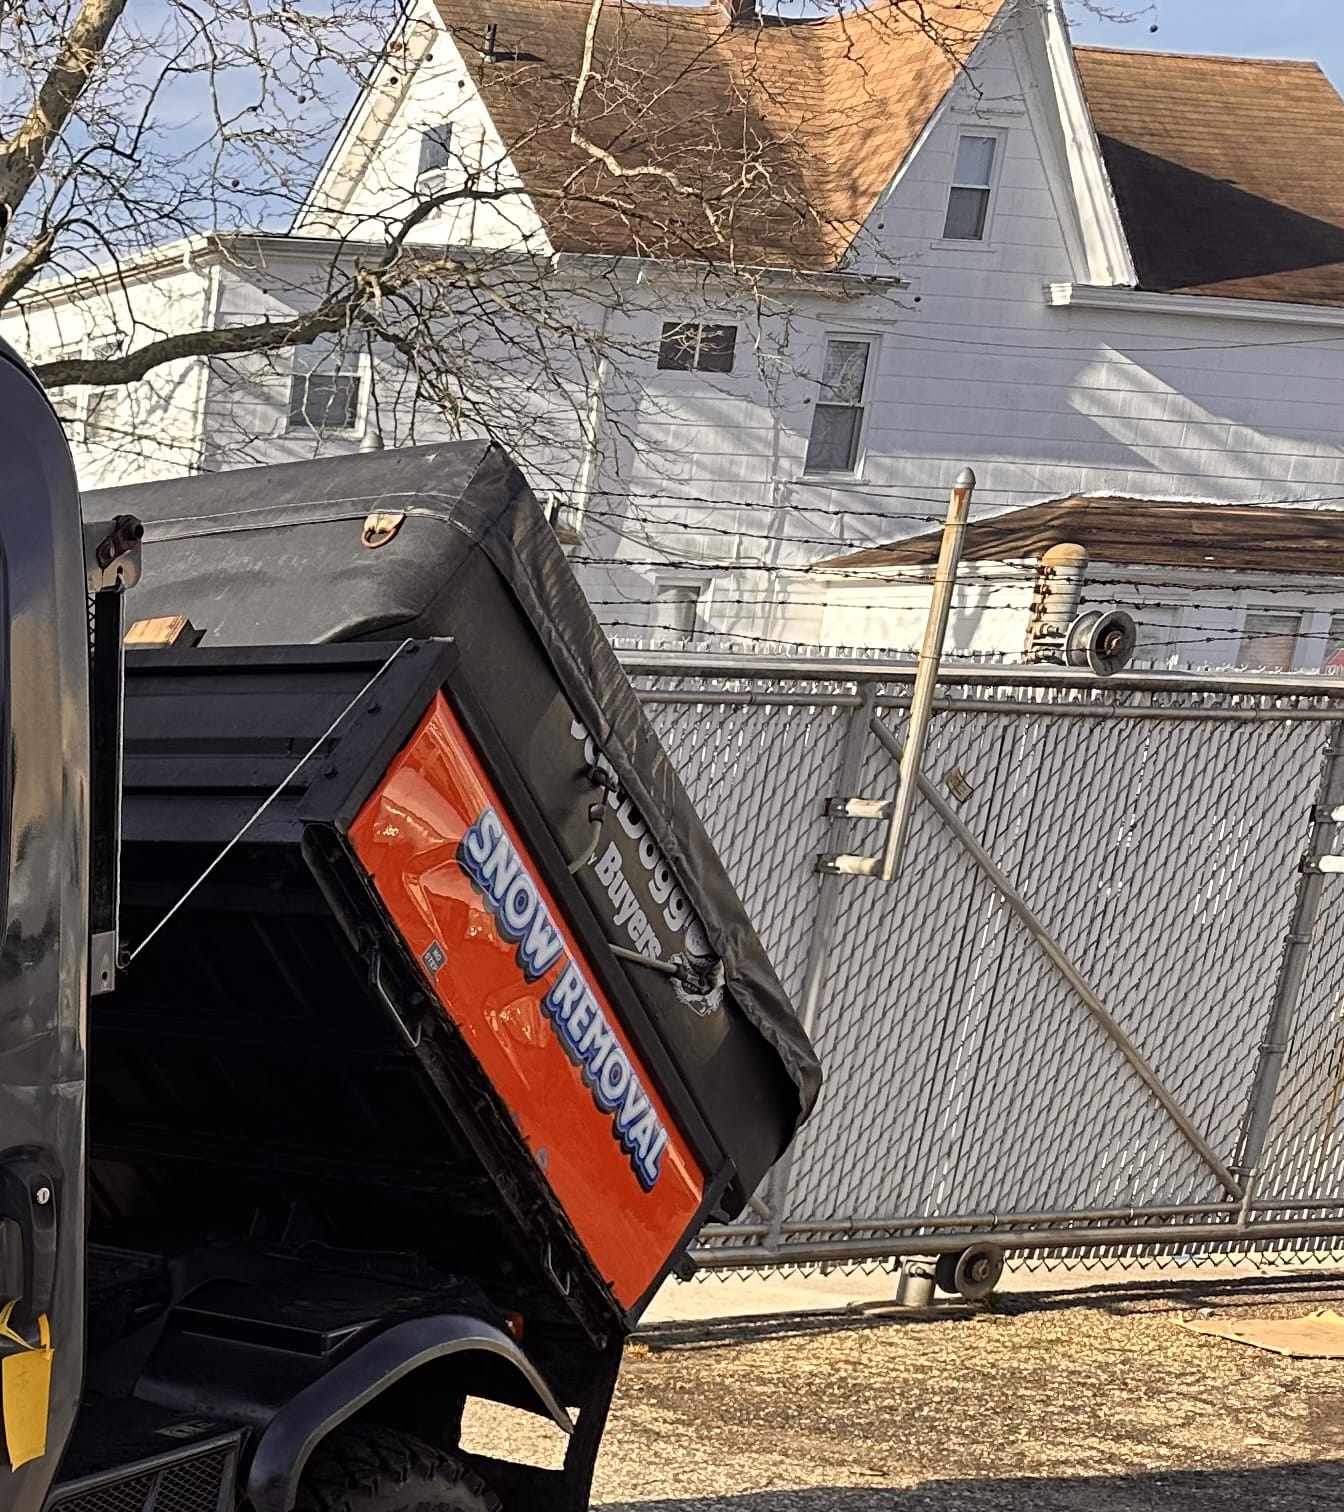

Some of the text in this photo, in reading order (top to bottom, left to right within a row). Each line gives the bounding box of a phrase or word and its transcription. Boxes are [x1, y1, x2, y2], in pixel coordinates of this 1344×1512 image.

[464, 806, 669, 1184] SNOW REMOVAL
[594, 841, 662, 961] Buyers
